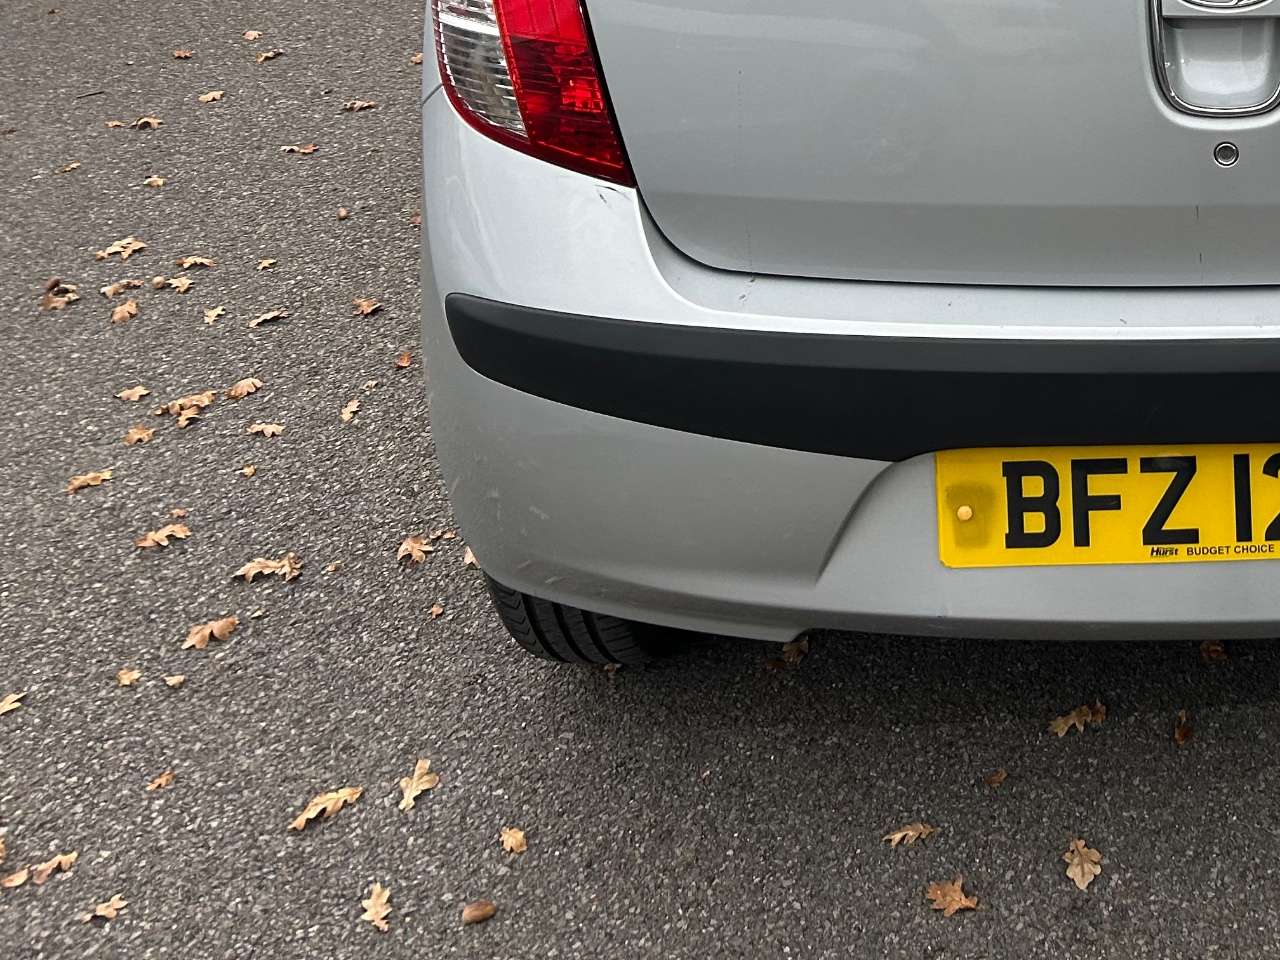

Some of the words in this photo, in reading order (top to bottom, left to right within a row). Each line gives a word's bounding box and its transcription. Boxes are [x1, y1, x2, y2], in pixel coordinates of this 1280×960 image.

[1002, 455, 1200, 549] BFZ
[1186, 545, 1231, 556] BUDGET
[1234, 543, 1275, 554] CHOICE
